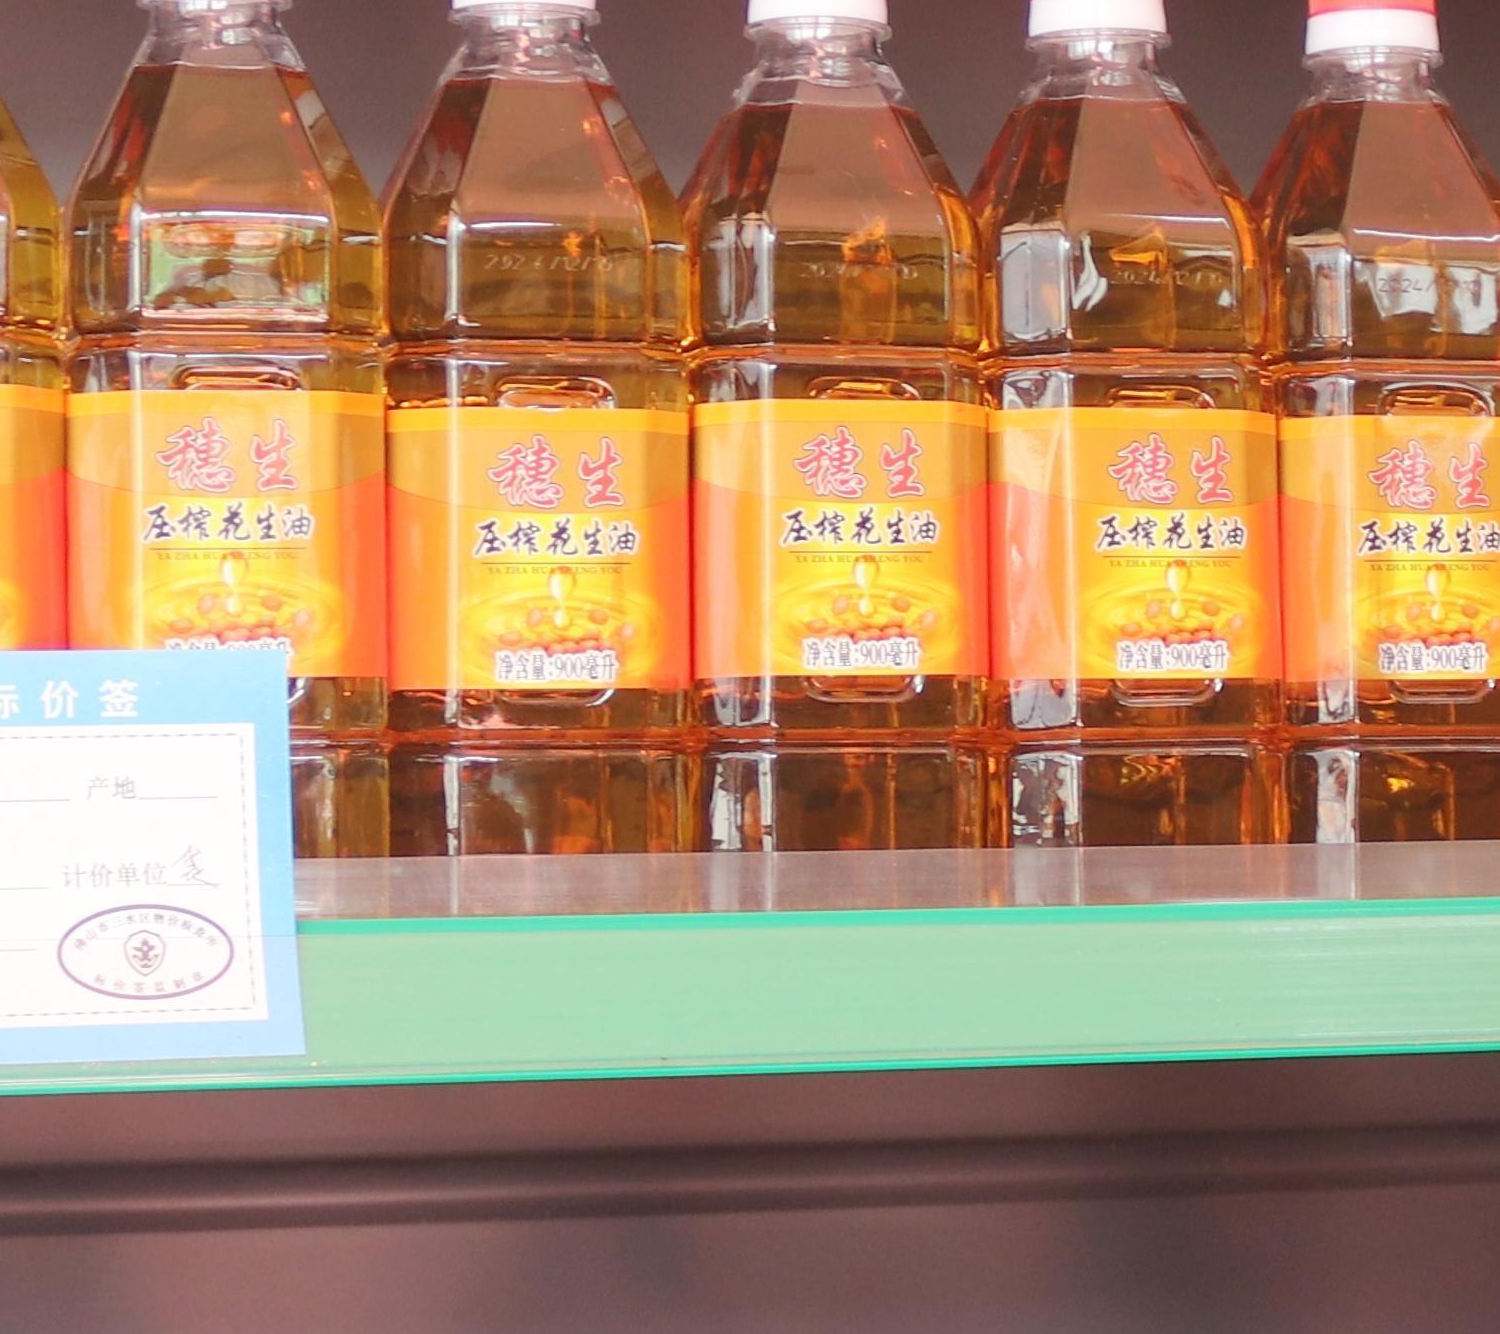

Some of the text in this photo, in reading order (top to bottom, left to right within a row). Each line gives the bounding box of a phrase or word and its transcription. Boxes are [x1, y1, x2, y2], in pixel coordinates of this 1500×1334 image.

[156, 418, 298, 493] 穗生
[487, 435, 624, 508] 穗生
[794, 426, 924, 498] 穗生
[1108, 433, 1232, 504] 穗生
[1369, 439, 1491, 508] 穗生
[142, 502, 313, 545] 压榨花生油
[472, 517, 640, 557] 压榨花生油
[778, 508, 940, 546] 压榨花生油
[1096, 515, 1246, 552] 压榨花生油
[85, 776, 136, 801] 产地
[62, 862, 169, 888] 计价单位
